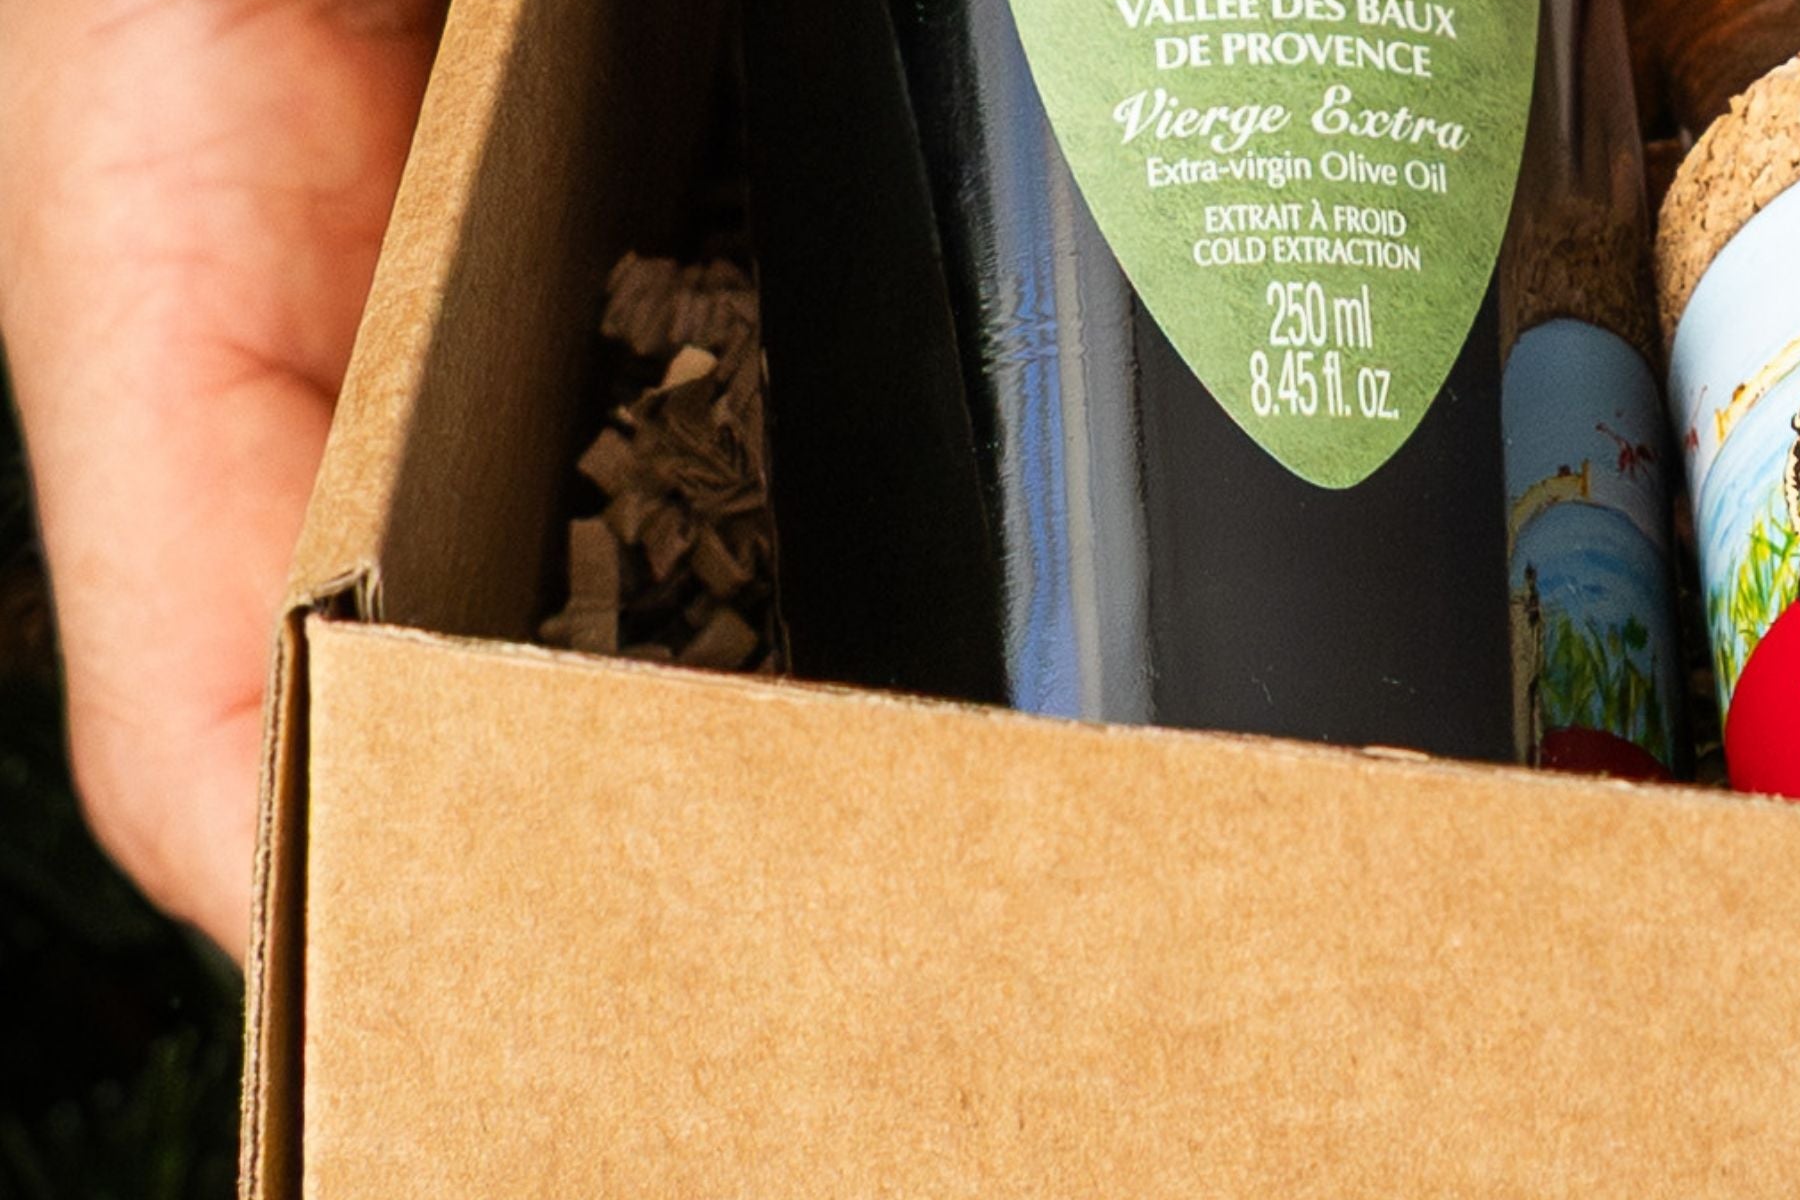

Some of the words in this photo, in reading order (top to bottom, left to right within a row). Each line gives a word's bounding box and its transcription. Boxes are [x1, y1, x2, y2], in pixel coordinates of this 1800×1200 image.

[1155, 35, 1211, 72] DE
[1222, 33, 1434, 80] PROVENCE
[1112, 87, 1291, 156] Vierge
[1311, 82, 1472, 154] Extra
[1146, 151, 1313, 191] Extra-virgin
[1320, 152, 1398, 188] Olive
[1404, 158, 1448, 194] Oil
[1204, 203, 1302, 236] EXTRAIT
[1308, 199, 1330, 235] À
[1332, 209, 1408, 239] FROID
[1192, 236, 1267, 269] COLD
[1273, 237, 1423, 273] EXTRACTION
[1266, 281, 1328, 349] 250
[1333, 283, 1374, 350] ml
[1249, 349, 1318, 418] 8.45
[1323, 351, 1352, 418] fl.
[1357, 366, 1400, 421] oz.
